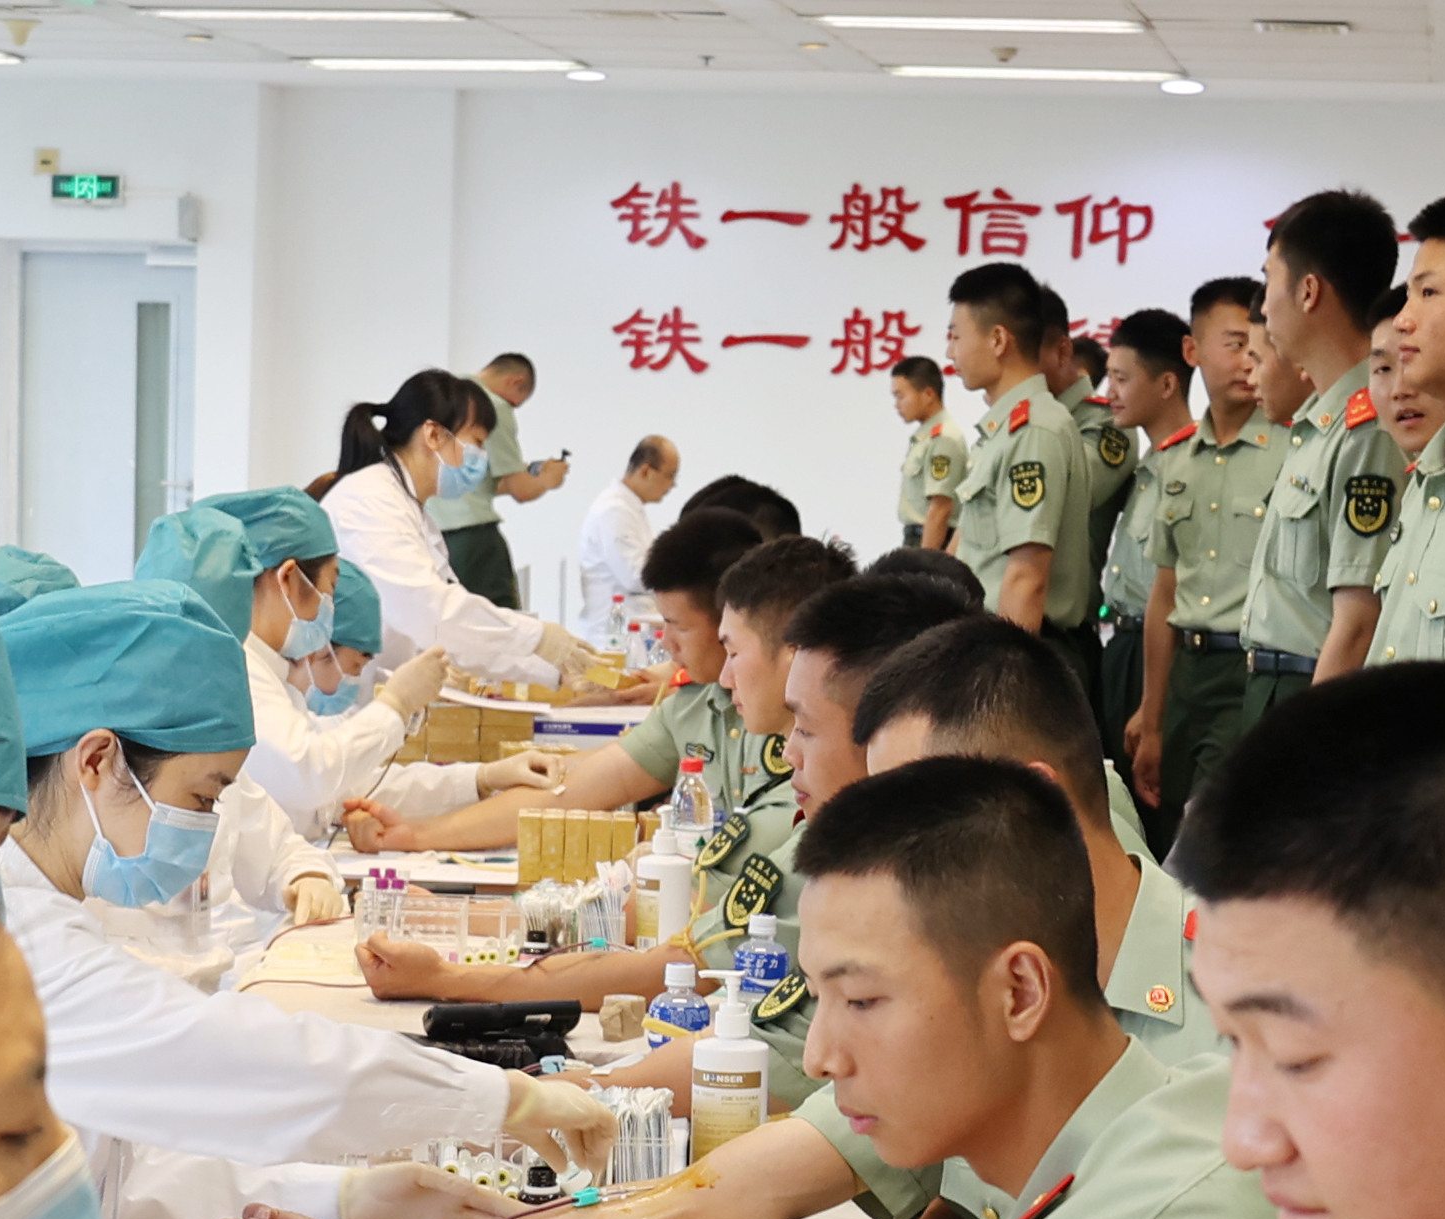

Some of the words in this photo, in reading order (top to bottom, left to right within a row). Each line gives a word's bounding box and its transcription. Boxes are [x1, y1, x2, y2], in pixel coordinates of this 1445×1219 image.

[610, 180, 1155, 264] 铁一般信仰
